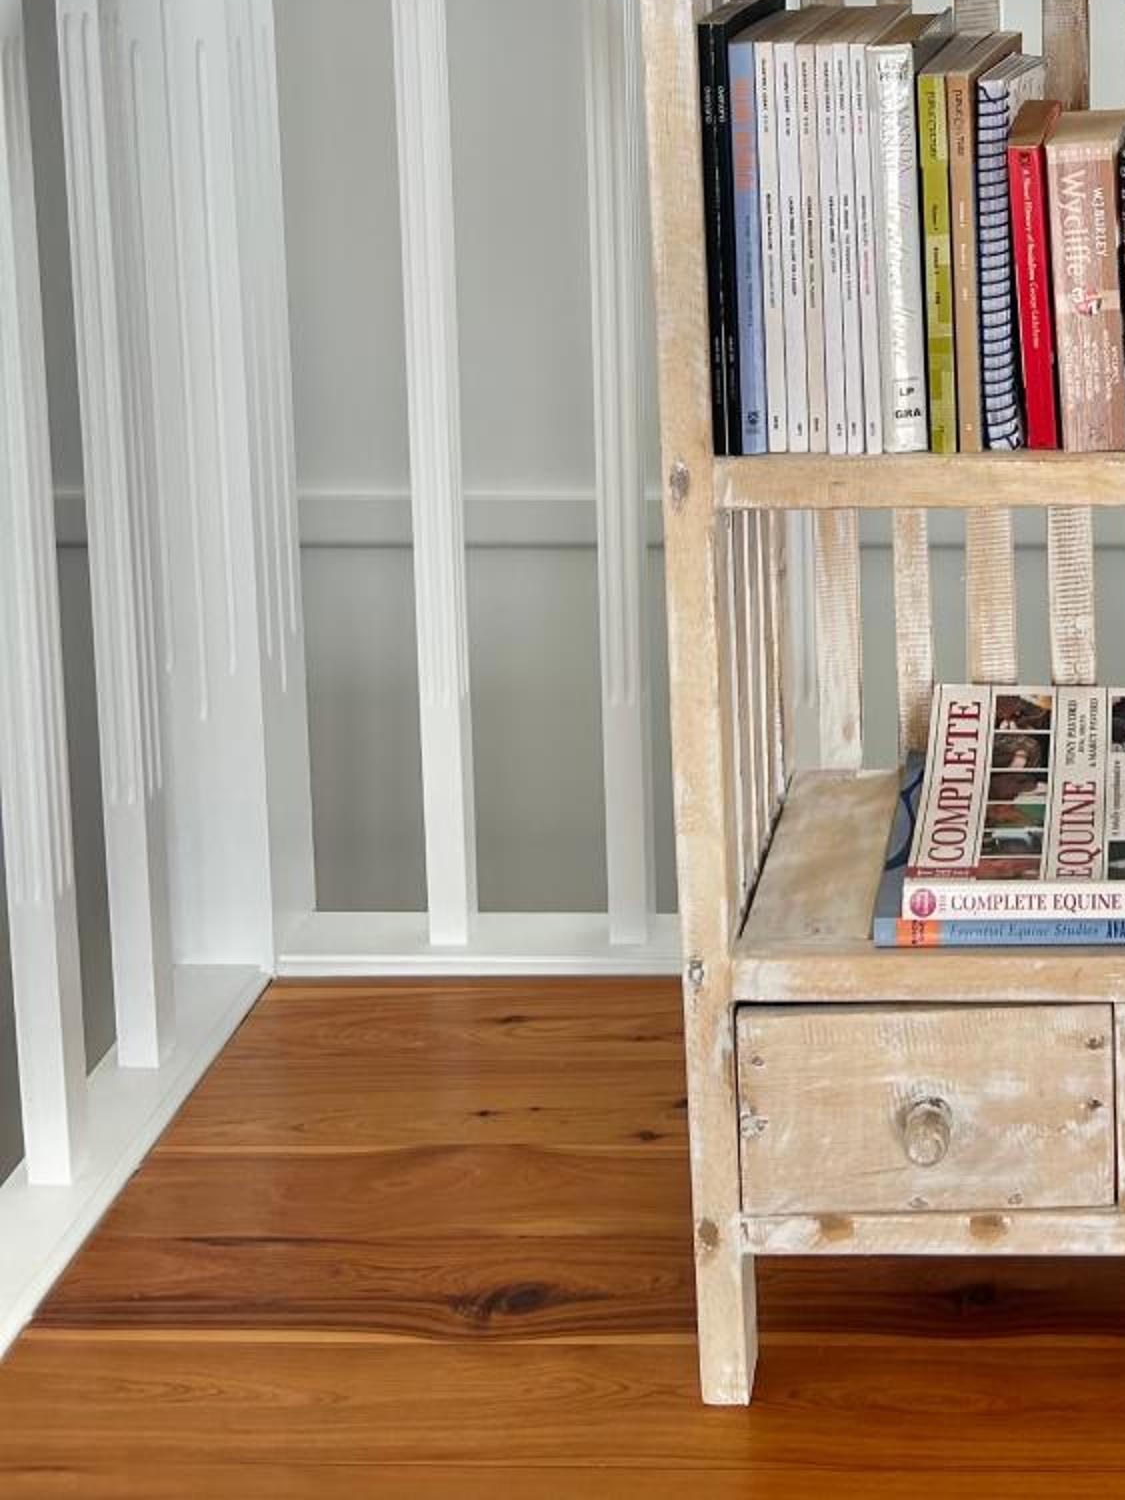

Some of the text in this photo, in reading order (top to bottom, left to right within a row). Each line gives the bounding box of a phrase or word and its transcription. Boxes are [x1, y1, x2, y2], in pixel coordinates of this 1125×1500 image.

[1058, 169, 1092, 277] Wycliffe
[1095, 209, 1110, 257] BURLEY
[899, 387, 915, 397] LP
[895, 407, 922, 419] GRA
[1065, 741, 1077, 766] TONY
[927, 701, 981, 863] COMPLETE
[1055, 781, 1101, 878] EQUINE
[951, 893, 1047, 911] COMPLETE
[1053, 893, 1122, 913] EQUINE
[950, 921, 1099, 941] Essential Equine Studies
